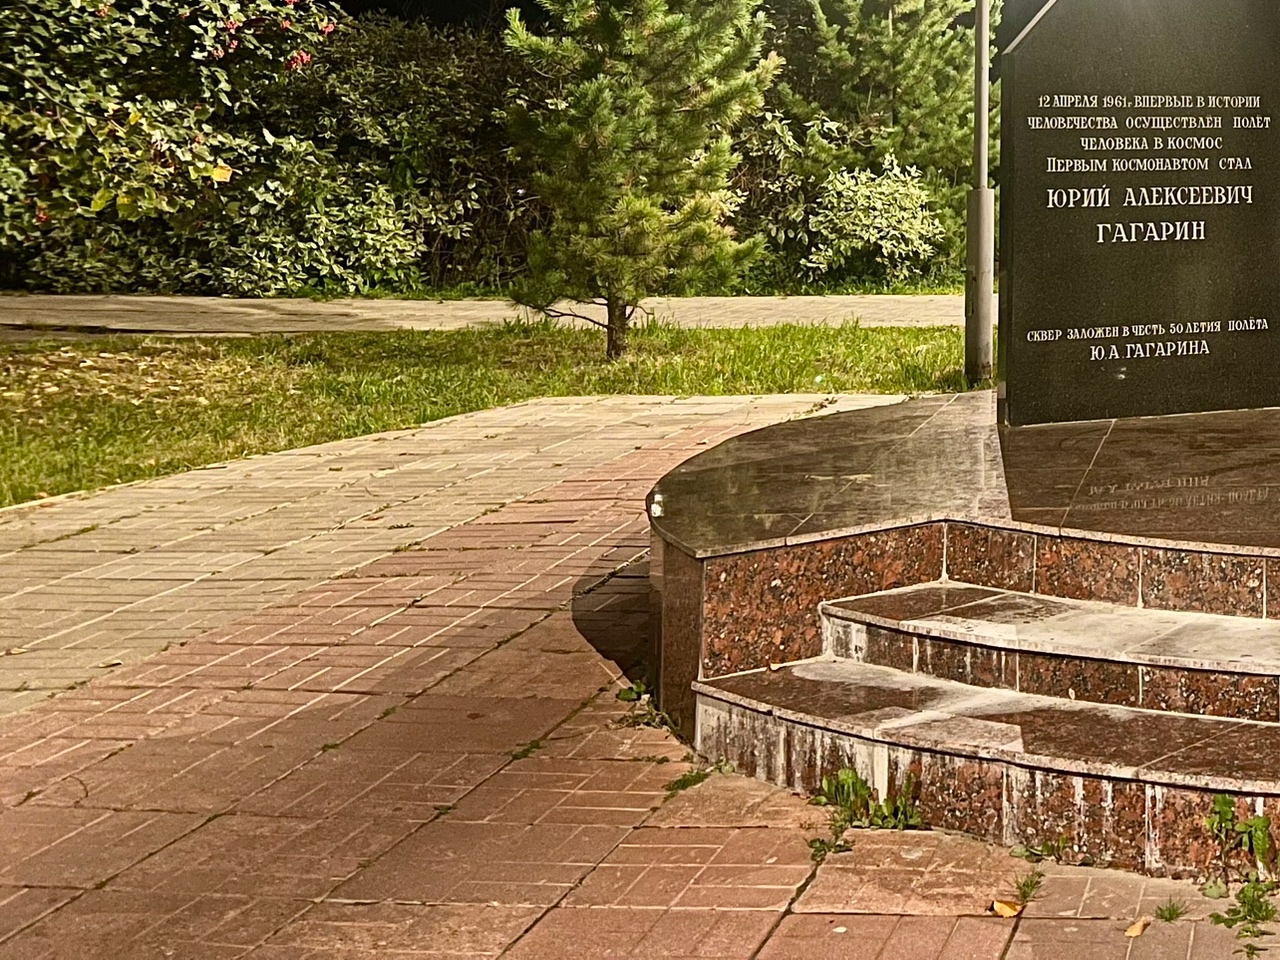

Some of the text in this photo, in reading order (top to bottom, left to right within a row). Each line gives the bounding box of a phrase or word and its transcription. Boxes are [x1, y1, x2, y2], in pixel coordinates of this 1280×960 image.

[1038, 94, 1051, 108] 12
[1052, 94, 1099, 108] АПРЕЛЯ
[1133, 95, 1194, 108] ВПЕРВЫЕ
[1196, 95, 1206, 108] В
[1207, 95, 1261, 109] ИСТОРИИ
[1027, 114, 1271, 132] ЧЕЛОВЕЧЕСТВА ОСУЩЕСТВЛЁН ПОЛЁТ
[1079, 136, 1223, 151] ЧЕЛОВЕКА В КОСМОС
[1046, 157, 1253, 173] ПЕРВЫМ КОСМОНАВТОМ СТАЛ
[1046, 183, 1253, 208] ЮРИЙ АЛЕКСЕЕВИЧ
[1096, 220, 1206, 243] ГАГАРИН
[1026, 316, 1269, 342] СКВЕР ЗАЛОЖЕН В ЧЕСТЬ 50 ЛЕТИЯ ПОЛЁТА
